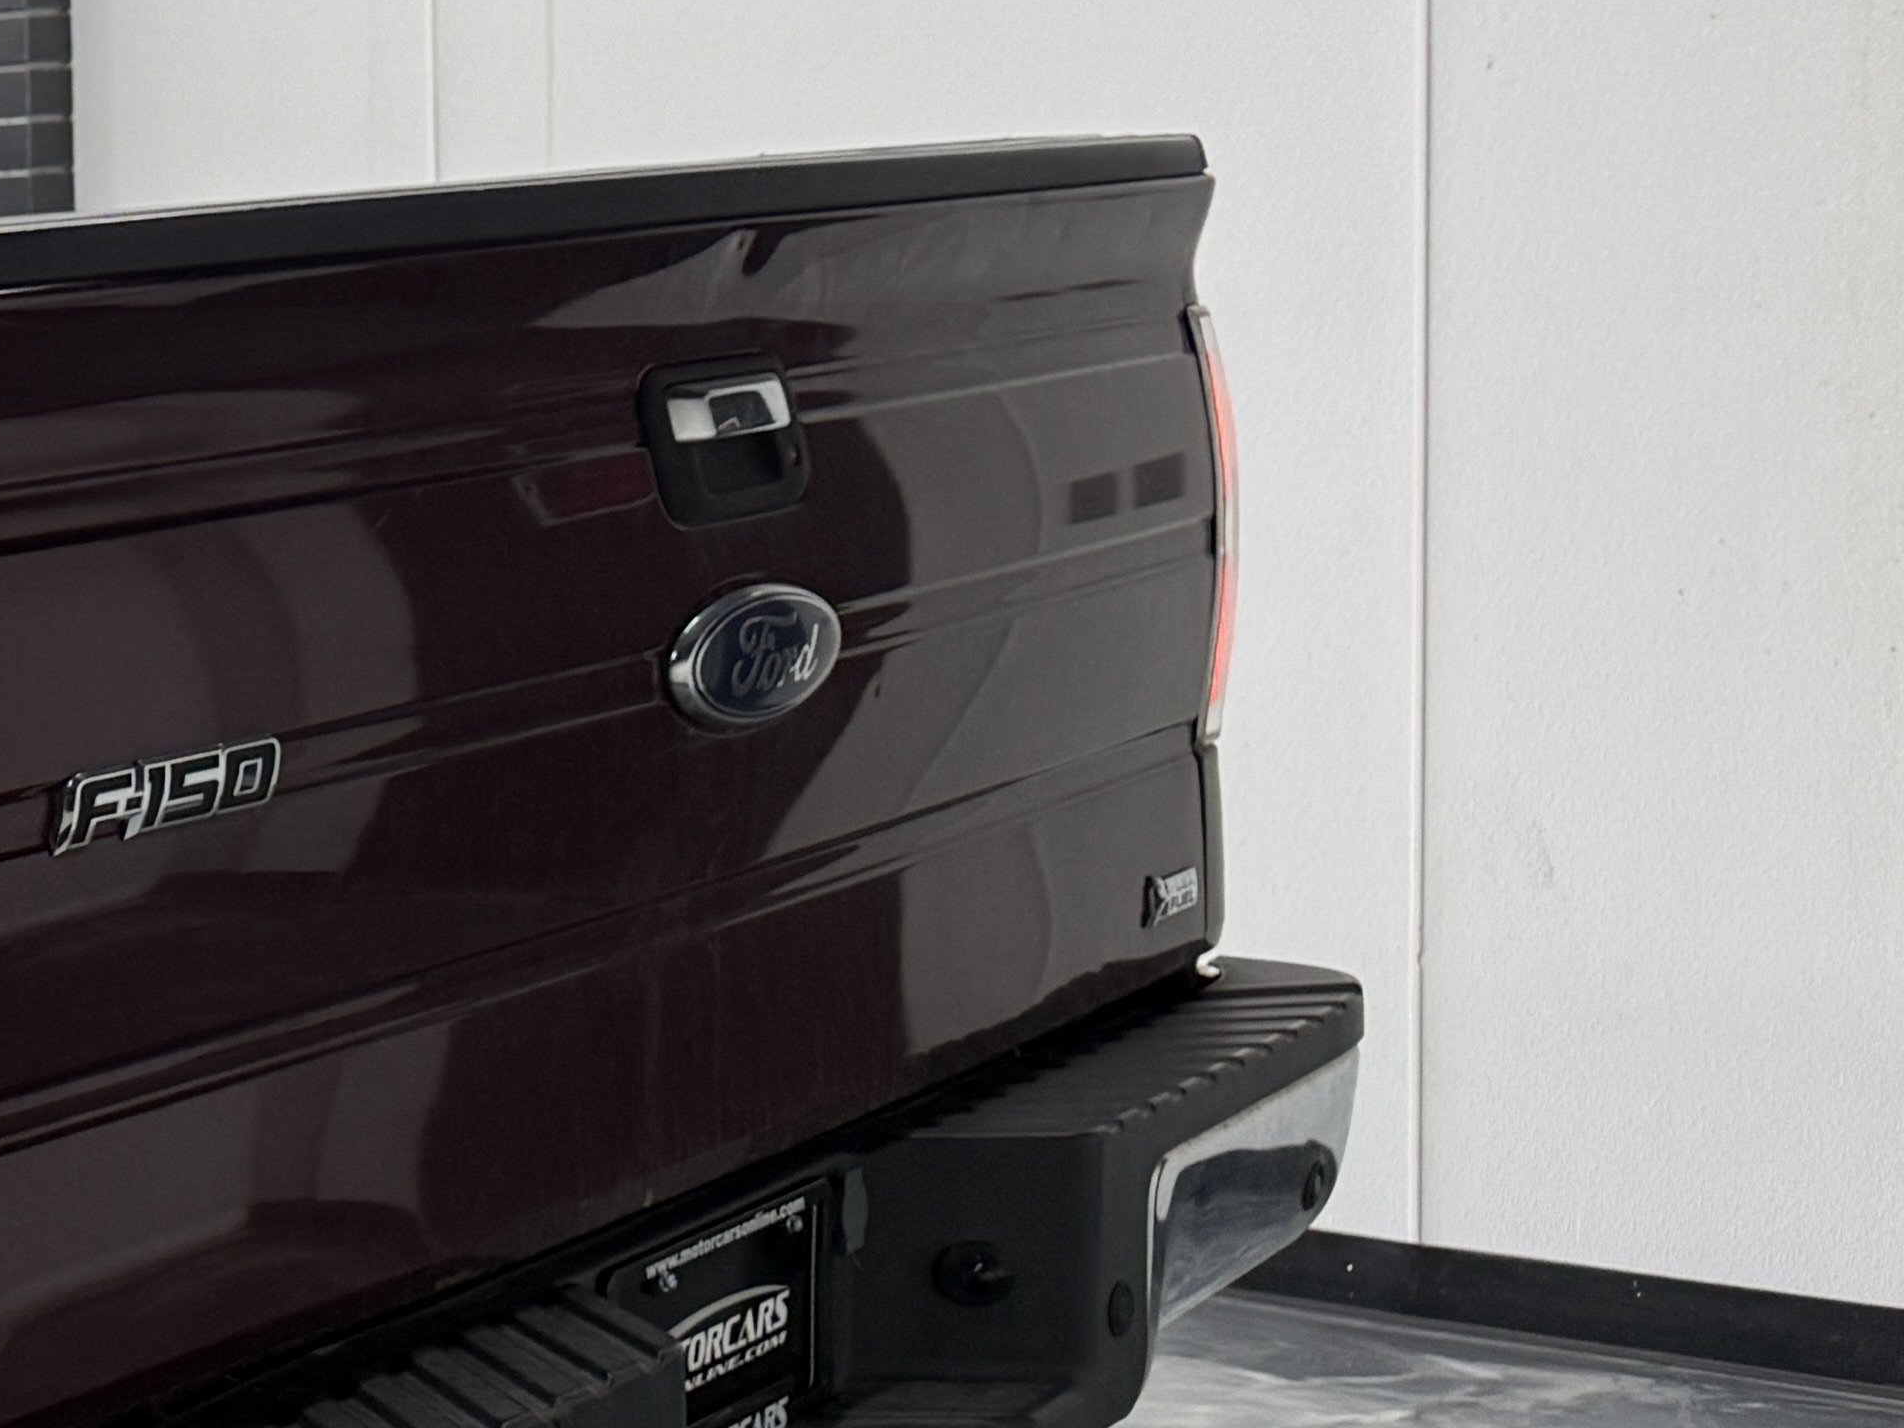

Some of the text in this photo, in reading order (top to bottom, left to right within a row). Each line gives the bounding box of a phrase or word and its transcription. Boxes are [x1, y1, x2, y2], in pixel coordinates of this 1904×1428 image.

[730, 610, 821, 698] Ford
[51, 736, 282, 857] F-150
[645, 1195, 806, 1281] www.motorcarsonline.com
